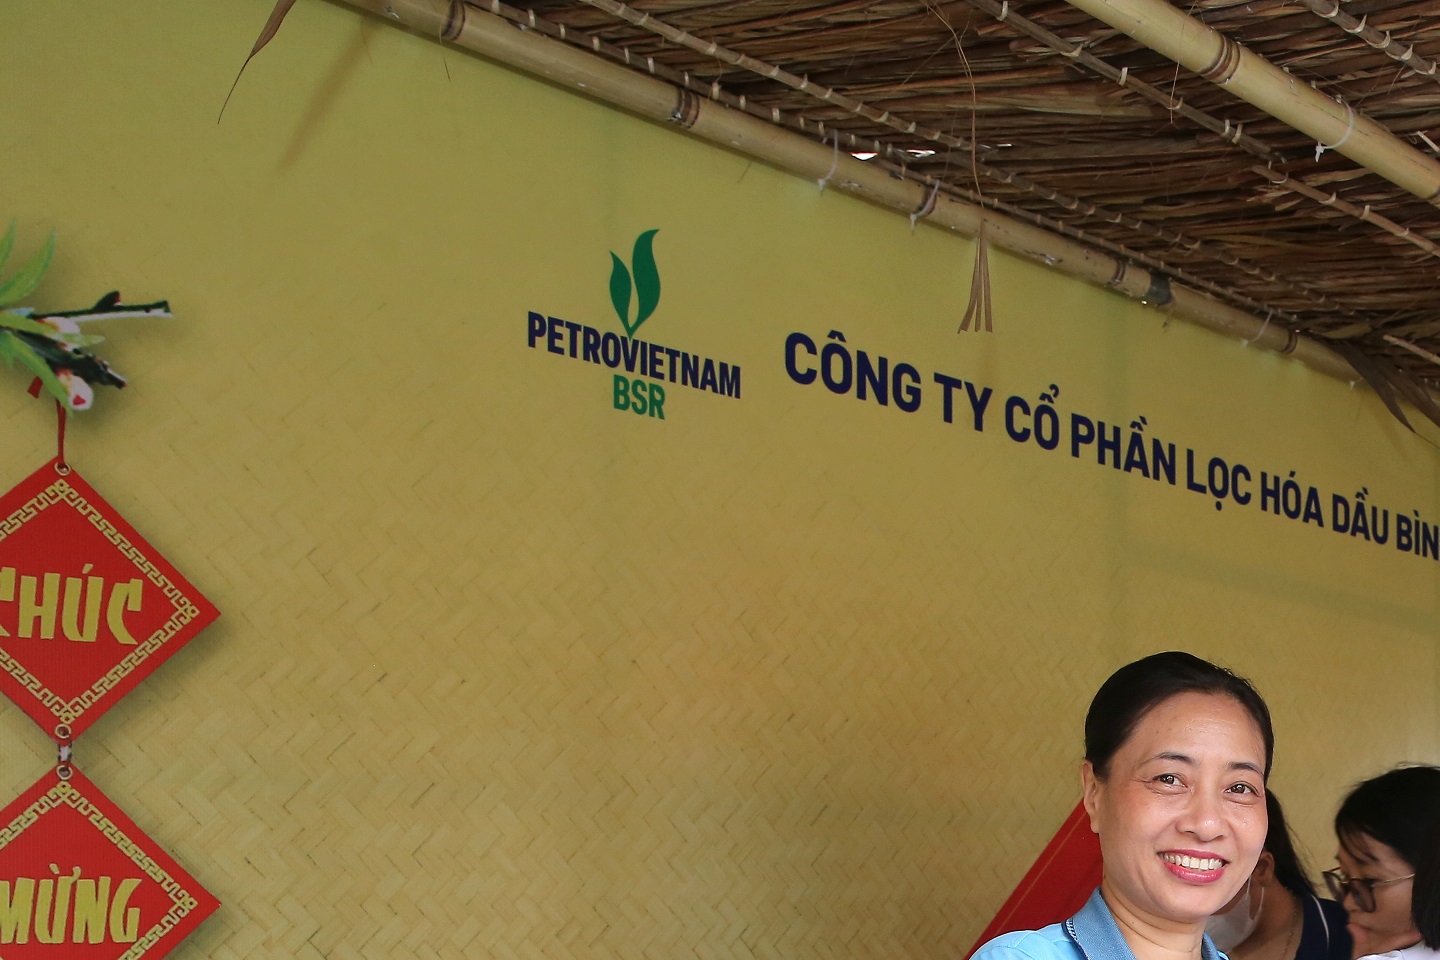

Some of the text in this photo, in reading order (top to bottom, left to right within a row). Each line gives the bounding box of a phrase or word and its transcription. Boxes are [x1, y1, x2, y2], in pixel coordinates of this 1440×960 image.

[527, 311, 741, 399] PETROVIETNAM
[612, 374, 665, 420] BSR
[784, 330, 922, 413] CÔNG
[934, 372, 993, 433] TY
[1004, 384, 1060, 450] CỔ
[1070, 414, 1177, 486] PHẦN
[1186, 448, 1252, 511] LỌC
[1260, 470, 1324, 528] HÓA
[1332, 486, 1389, 545] DẦU
[0, 863, 142, 945] MỪNG
